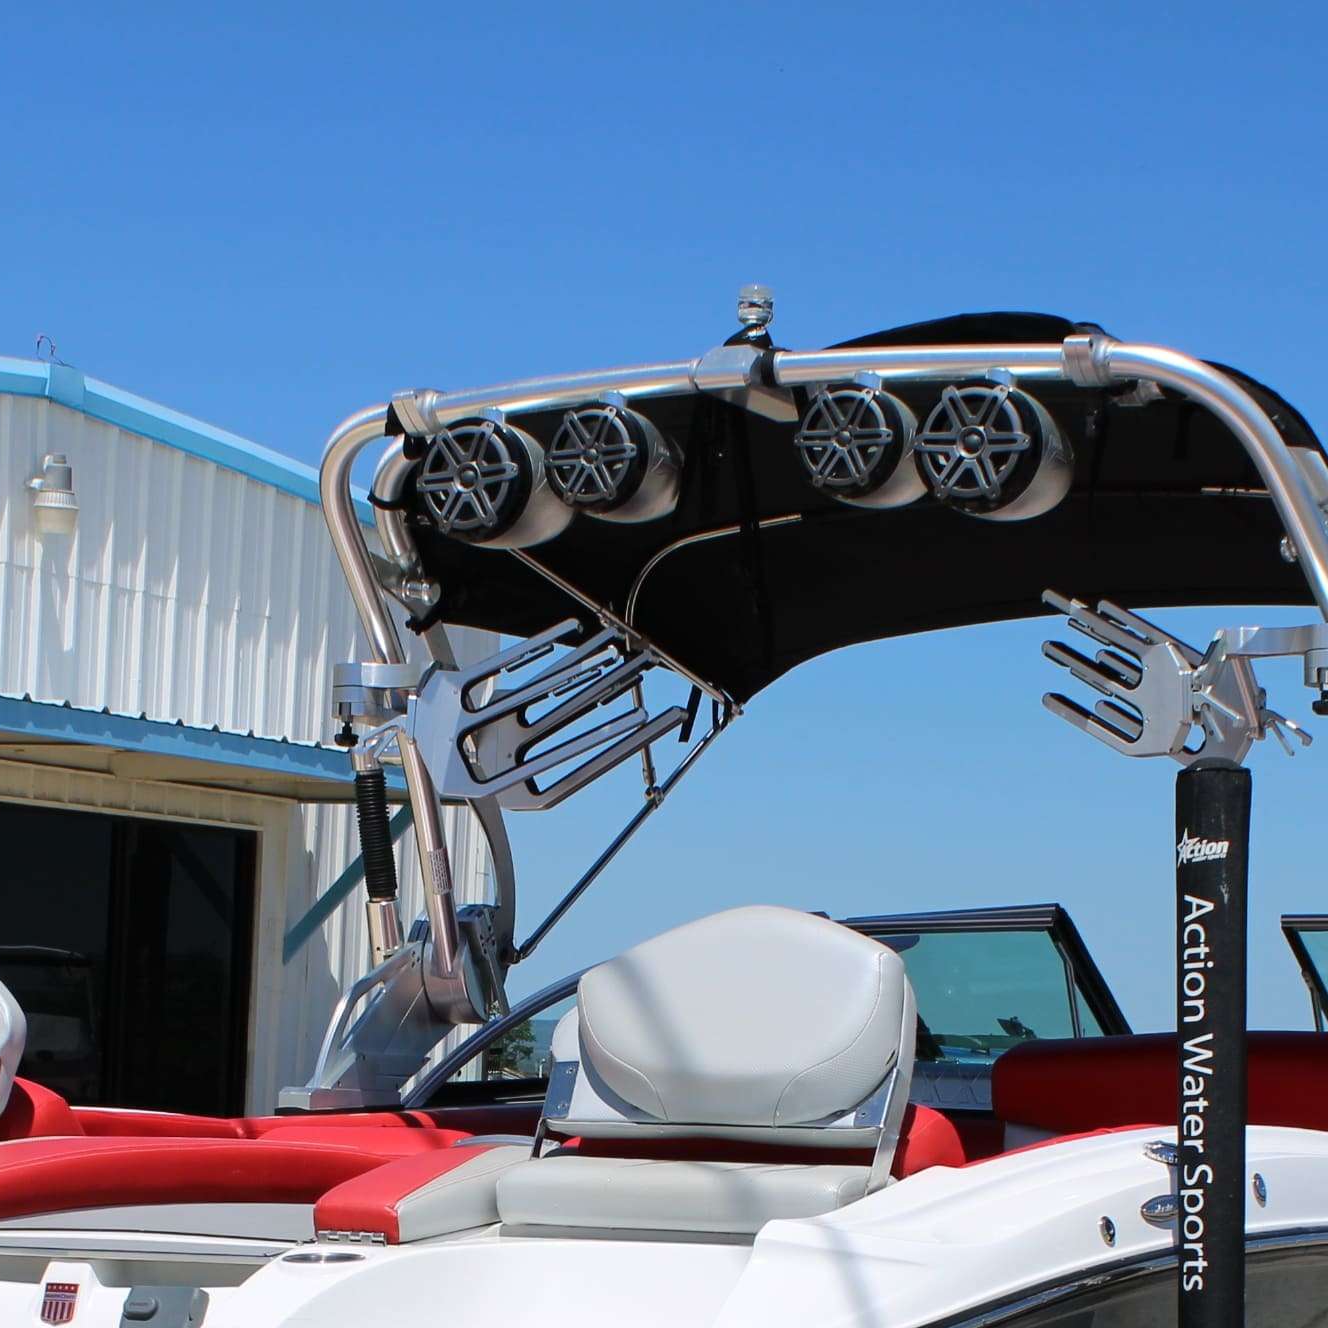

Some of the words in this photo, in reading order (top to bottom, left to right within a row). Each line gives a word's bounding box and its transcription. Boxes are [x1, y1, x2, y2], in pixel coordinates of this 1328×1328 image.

[1183, 894, 1214, 1023] Action
[1182, 1033, 1213, 1153] Water
[1181, 1163, 1213, 1292] Sports
